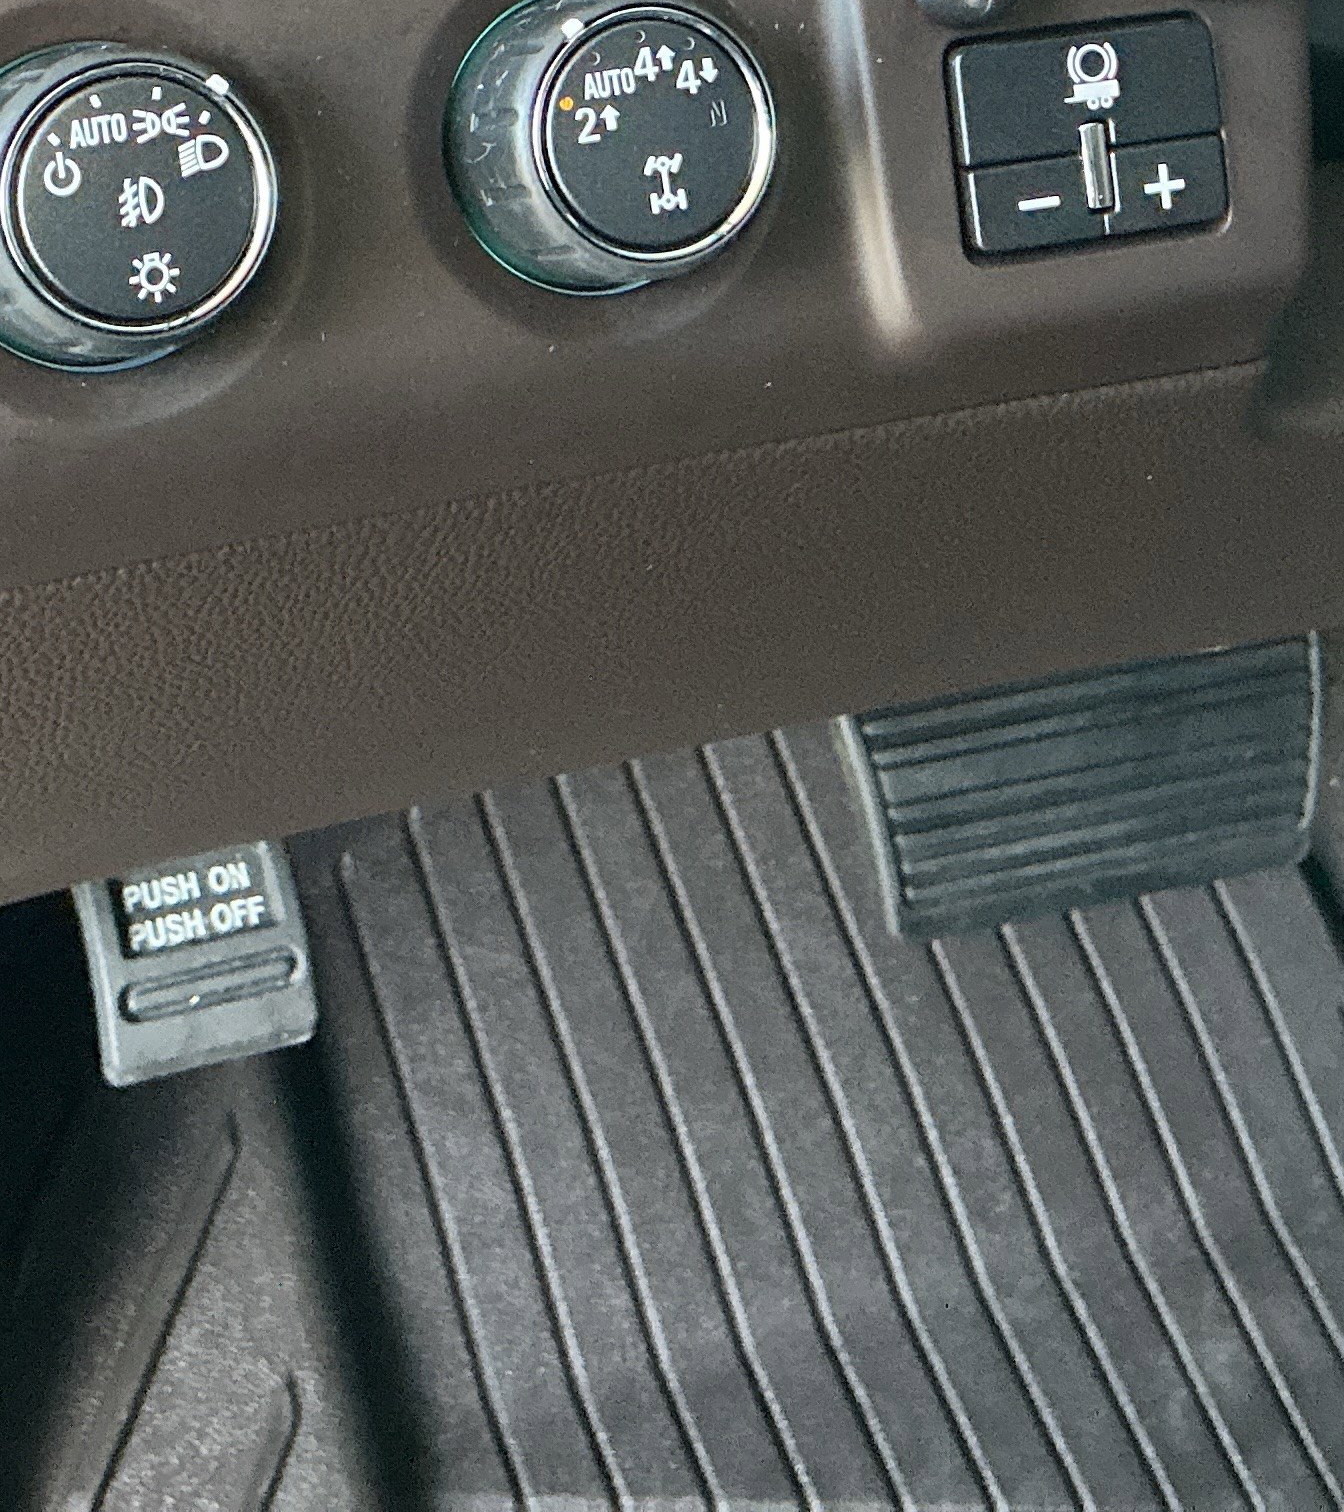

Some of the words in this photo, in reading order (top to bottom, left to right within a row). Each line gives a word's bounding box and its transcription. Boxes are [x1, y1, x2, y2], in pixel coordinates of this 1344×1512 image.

[632, 45, 660, 82] 4
[676, 59, 702, 95] 4
[583, 66, 637, 101] AUTO
[69, 113, 128, 150] AUTO
[573, 106, 602, 146] 2
[122, 870, 202, 914] PUSH
[207, 860, 252, 895] ON
[127, 908, 207, 953] PUSH
[209, 894, 267, 934] OFF
